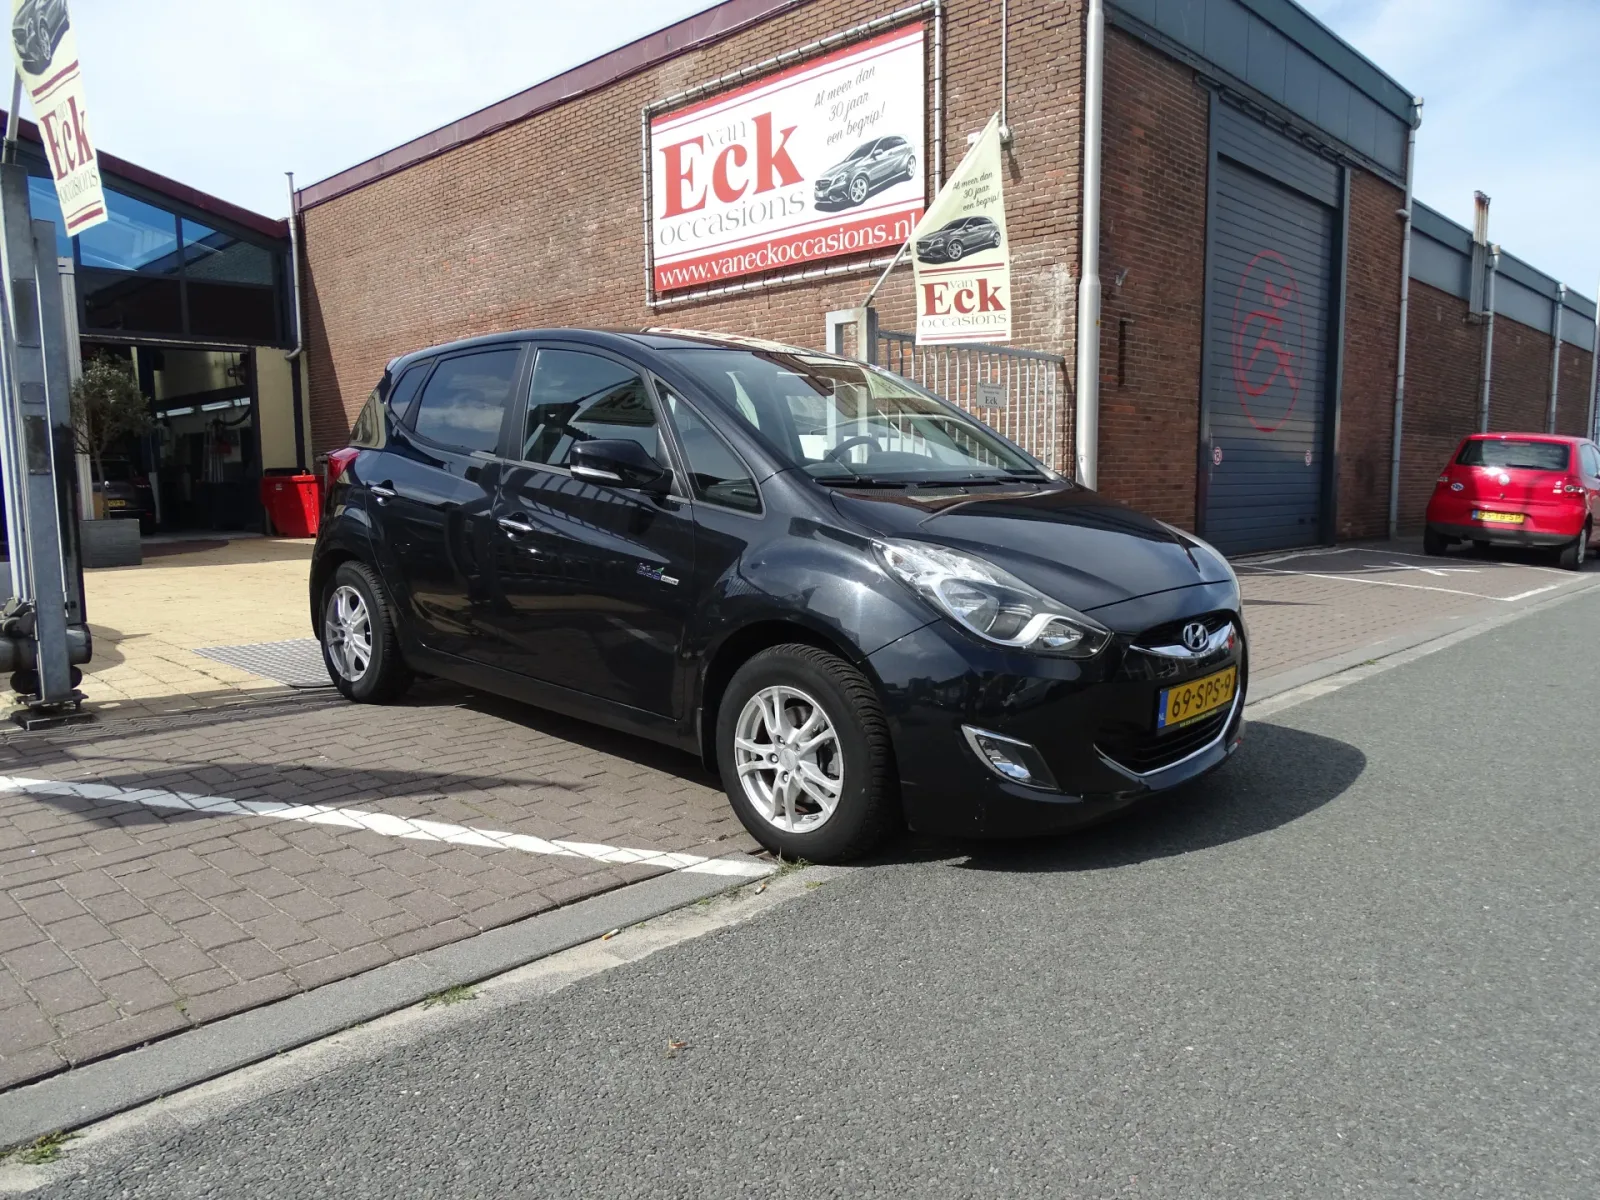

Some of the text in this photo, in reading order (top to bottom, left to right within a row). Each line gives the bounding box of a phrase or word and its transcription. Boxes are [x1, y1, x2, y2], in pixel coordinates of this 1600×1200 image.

[813, 65, 876, 109] Al meer dan
[826, 100, 886, 146] een begrip!
[828, 91, 869, 123] 30 jaar
[40, 95, 94, 181] Eck
[706, 121, 747, 148] van
[659, 111, 805, 220] Eck
[961, 177, 979, 188] meer
[979, 171, 993, 182] dan
[962, 202, 975, 211] een
[963, 184, 990, 200] 30 jaar
[659, 190, 806, 246] occasions
[659, 211, 916, 287] www.vaneckoccasions.nl
[920, 278, 1007, 317] Eck
[949, 278, 974, 289] van
[921, 313, 1007, 329] occasions
[1171, 672, 1232, 719] 69-SPS-9
